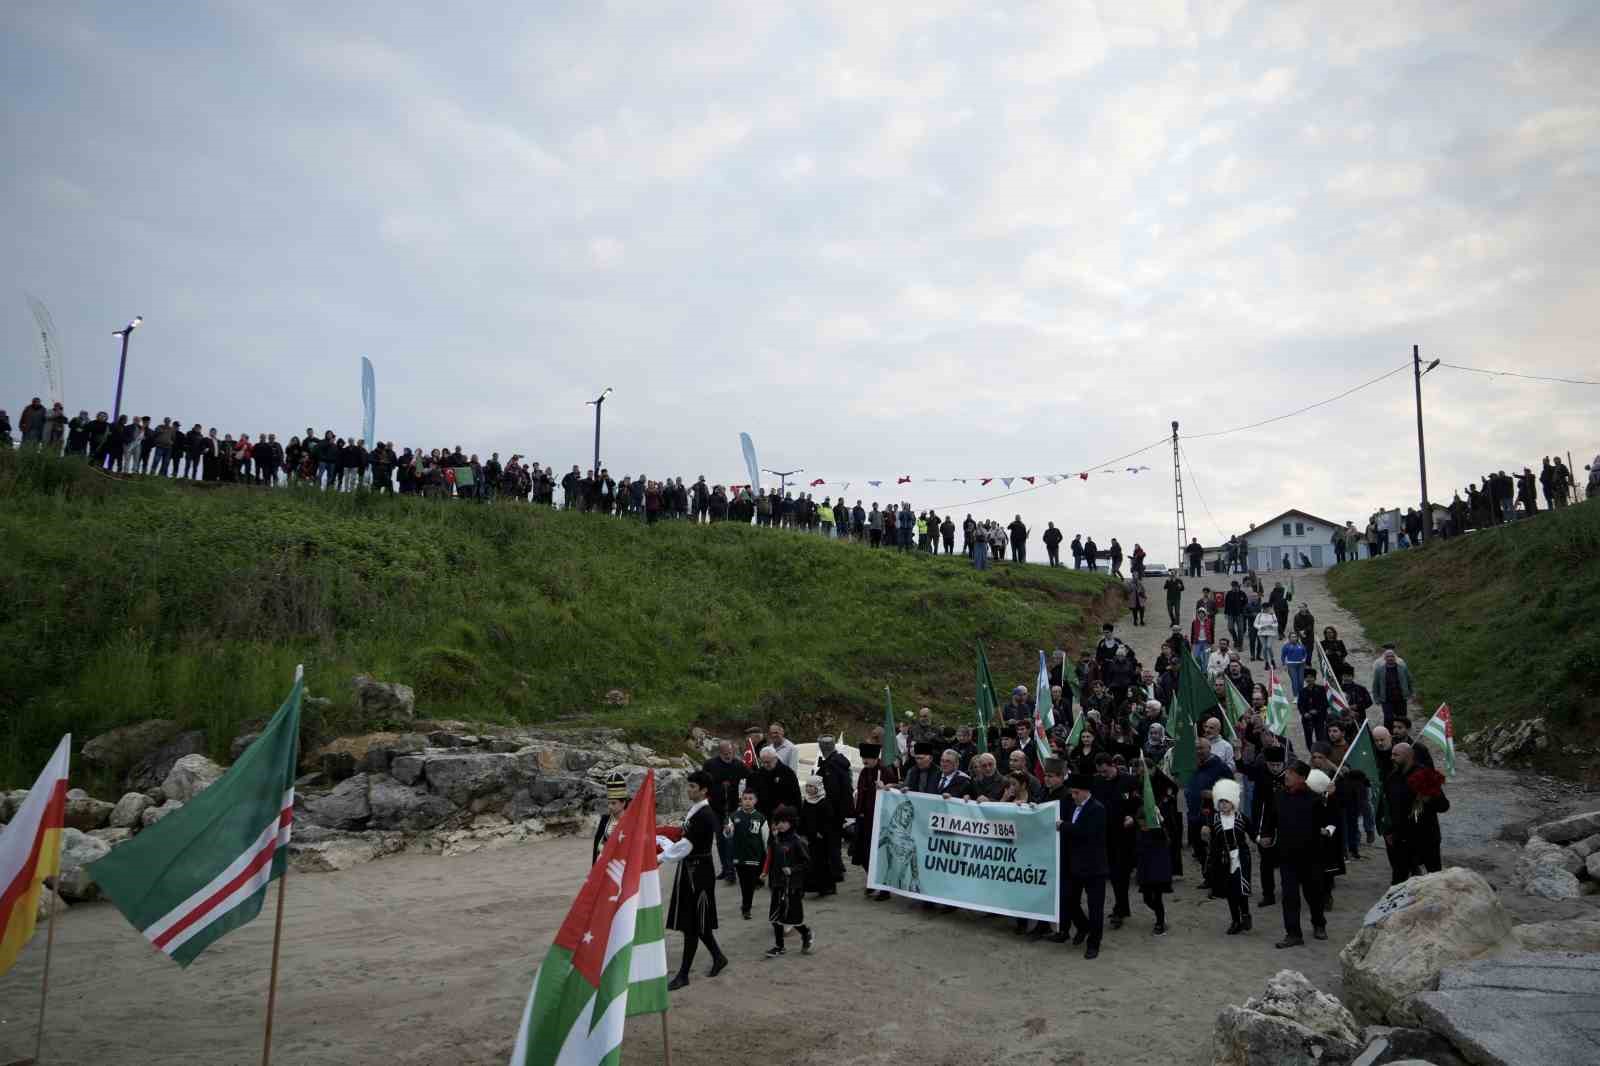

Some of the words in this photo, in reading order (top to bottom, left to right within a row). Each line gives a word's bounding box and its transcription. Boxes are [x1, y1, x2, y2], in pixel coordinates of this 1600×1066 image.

[931, 815, 945, 828] 21
[949, 818, 990, 835] MAYIS
[994, 823, 1015, 837] 1864
[927, 836, 1018, 863] UNUTMADIK
[924, 855, 1048, 886] UNUTMAYACAĞIZ
